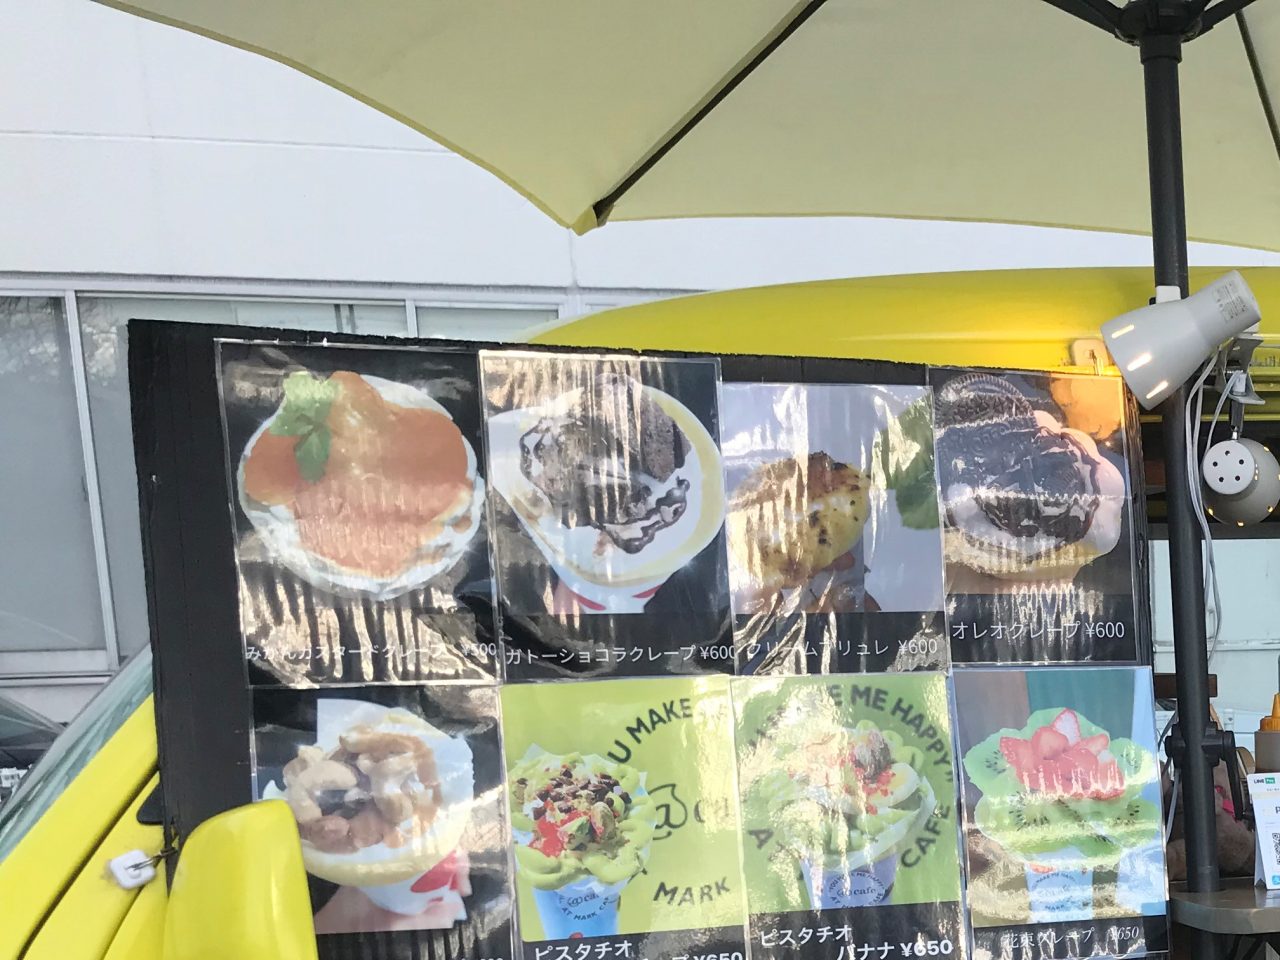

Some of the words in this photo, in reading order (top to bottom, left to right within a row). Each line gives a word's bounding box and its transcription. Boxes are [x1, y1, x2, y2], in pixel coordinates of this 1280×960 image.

[952, 620, 1081, 640] オレオクレープ
[1085, 620, 1125, 638] ¥600
[506, 644, 697, 665] ガトーショコラクレープ
[898, 639, 938, 655] ¥600
[625, 698, 693, 744] MAKE
[653, 876, 731, 907] MARK
[761, 924, 853, 947] ピスタチオ
[900, 938, 953, 957] ¥650
